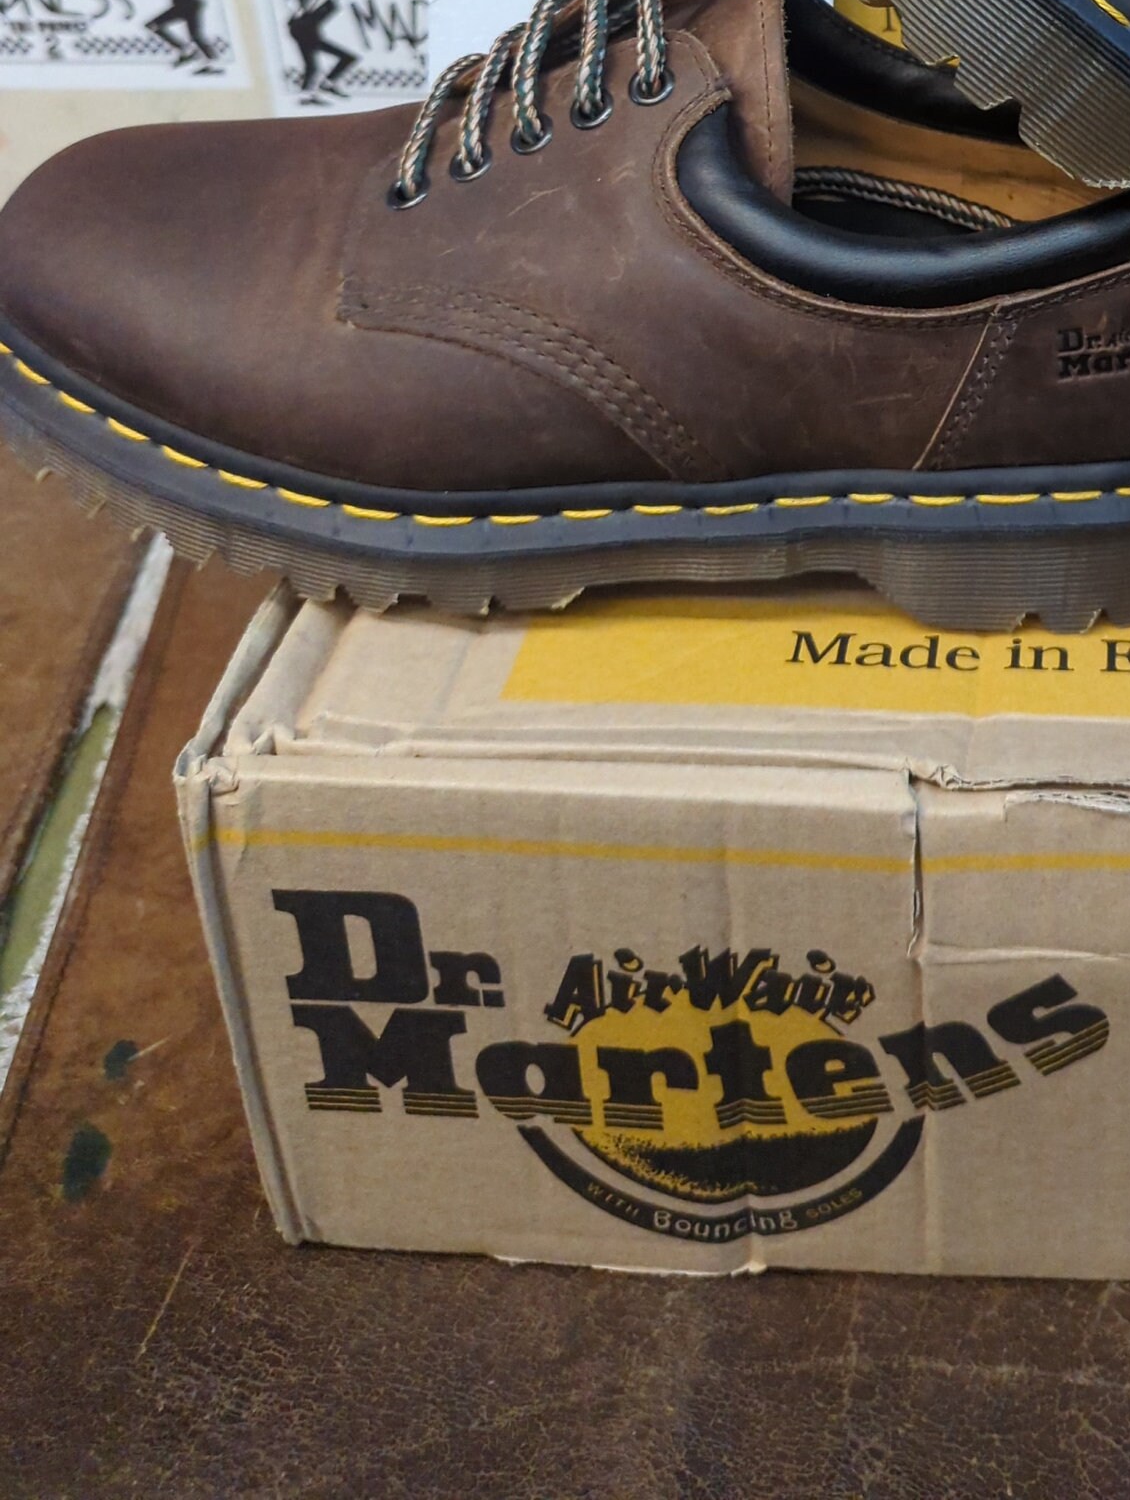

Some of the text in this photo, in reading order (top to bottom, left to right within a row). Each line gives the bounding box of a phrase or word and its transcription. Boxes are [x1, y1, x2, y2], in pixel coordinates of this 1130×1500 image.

[785, 630, 981, 672] Made
[1003, 637, 1075, 673] in
[545, 945, 876, 1036] AirWair
[291, 971, 1110, 1130] Martens
[586, 1180, 863, 1239] WITH Bouncing SOLES
